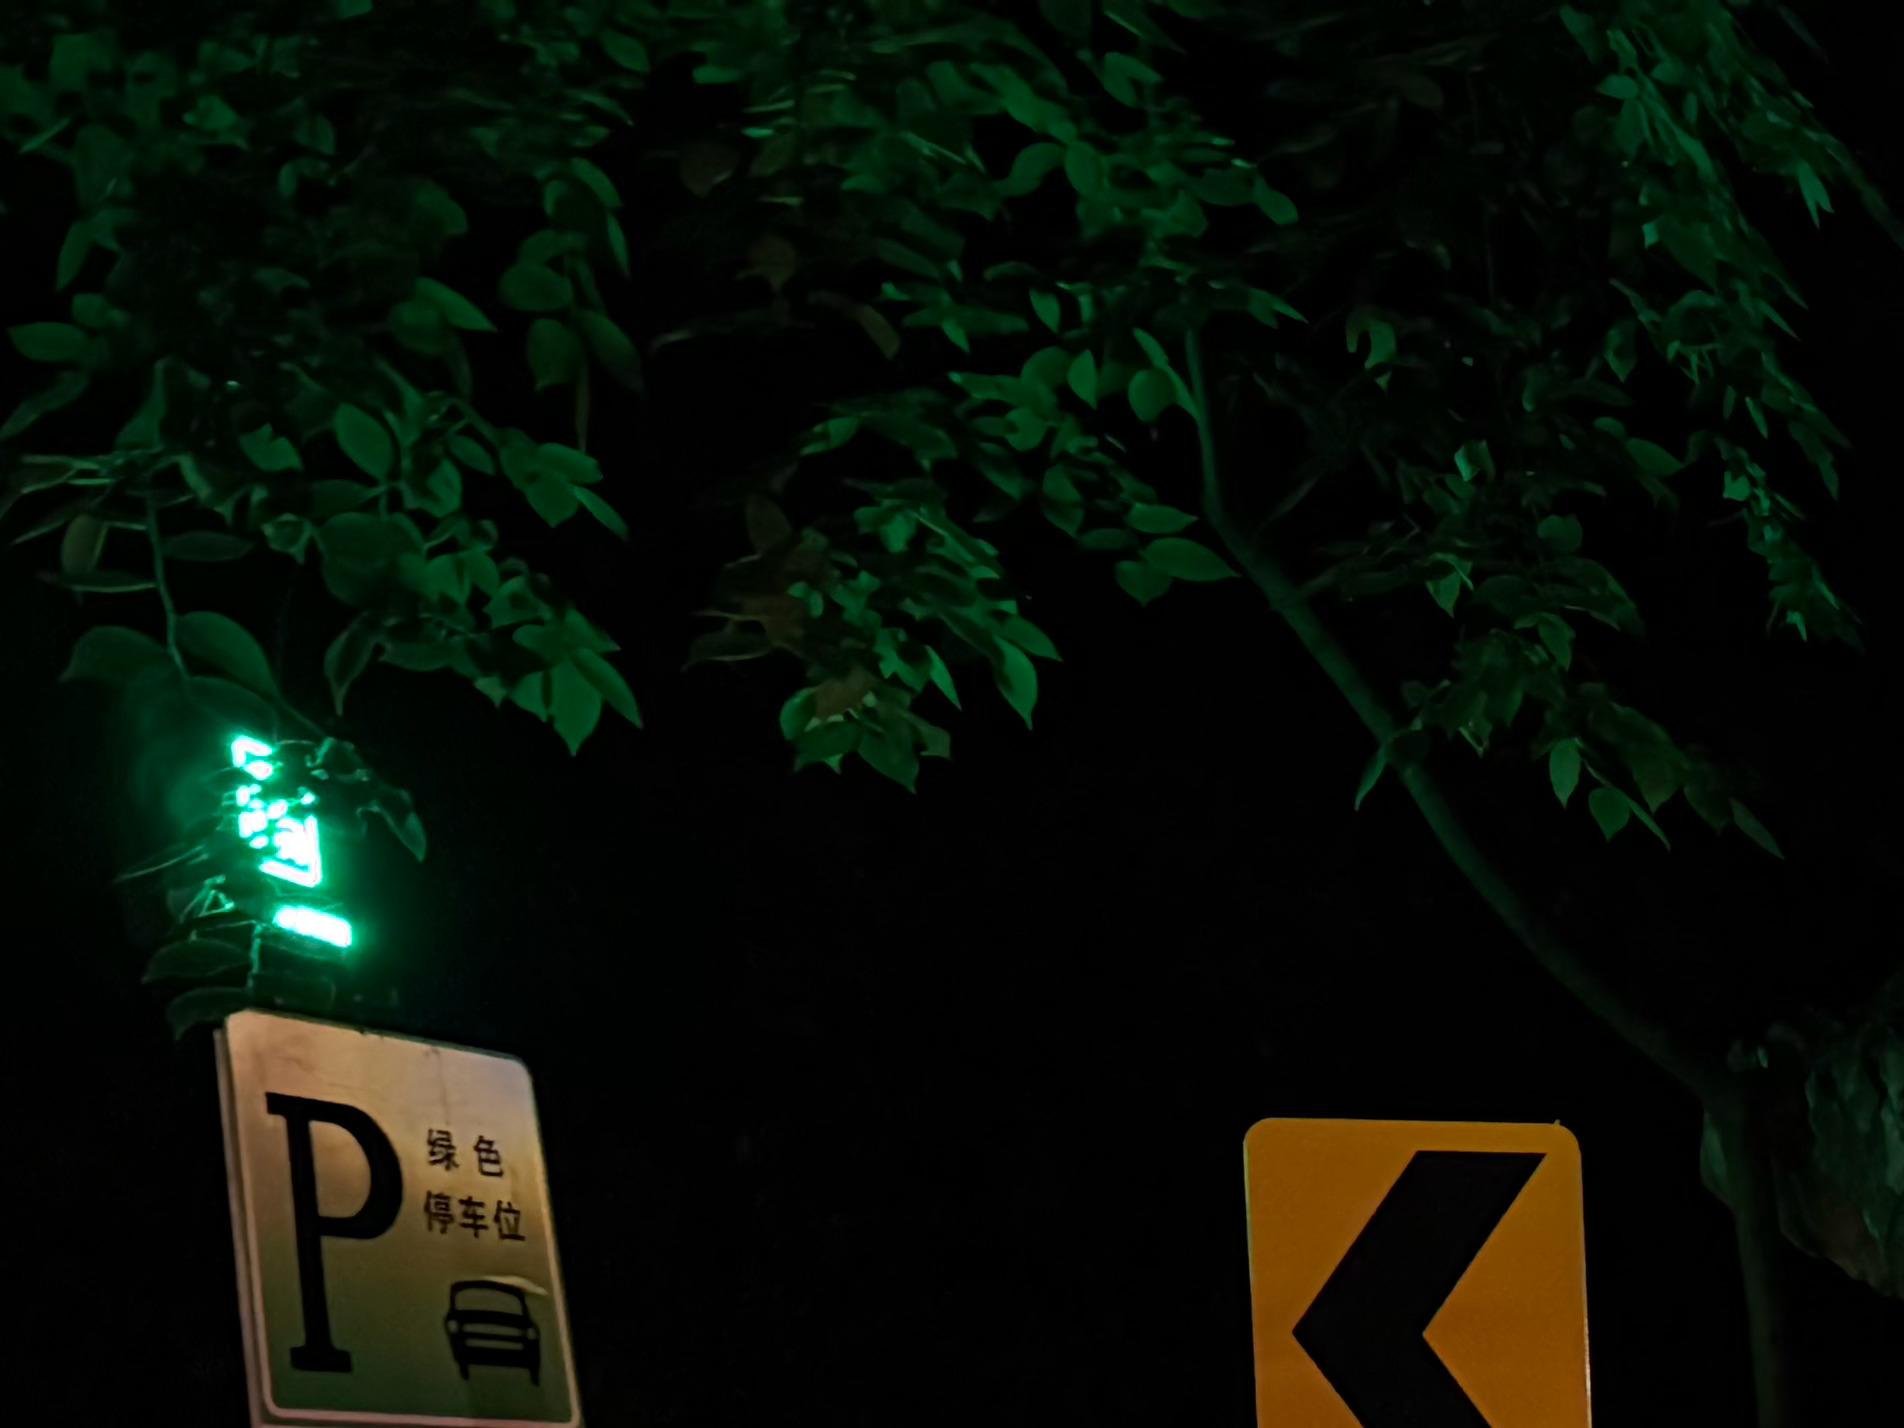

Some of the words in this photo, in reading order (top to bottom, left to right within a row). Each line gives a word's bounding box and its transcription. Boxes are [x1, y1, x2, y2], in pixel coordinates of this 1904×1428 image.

[426, 1128, 505, 1179] 绿色
[265, 1091, 404, 1373] P
[423, 1191, 525, 1241] 停车位
